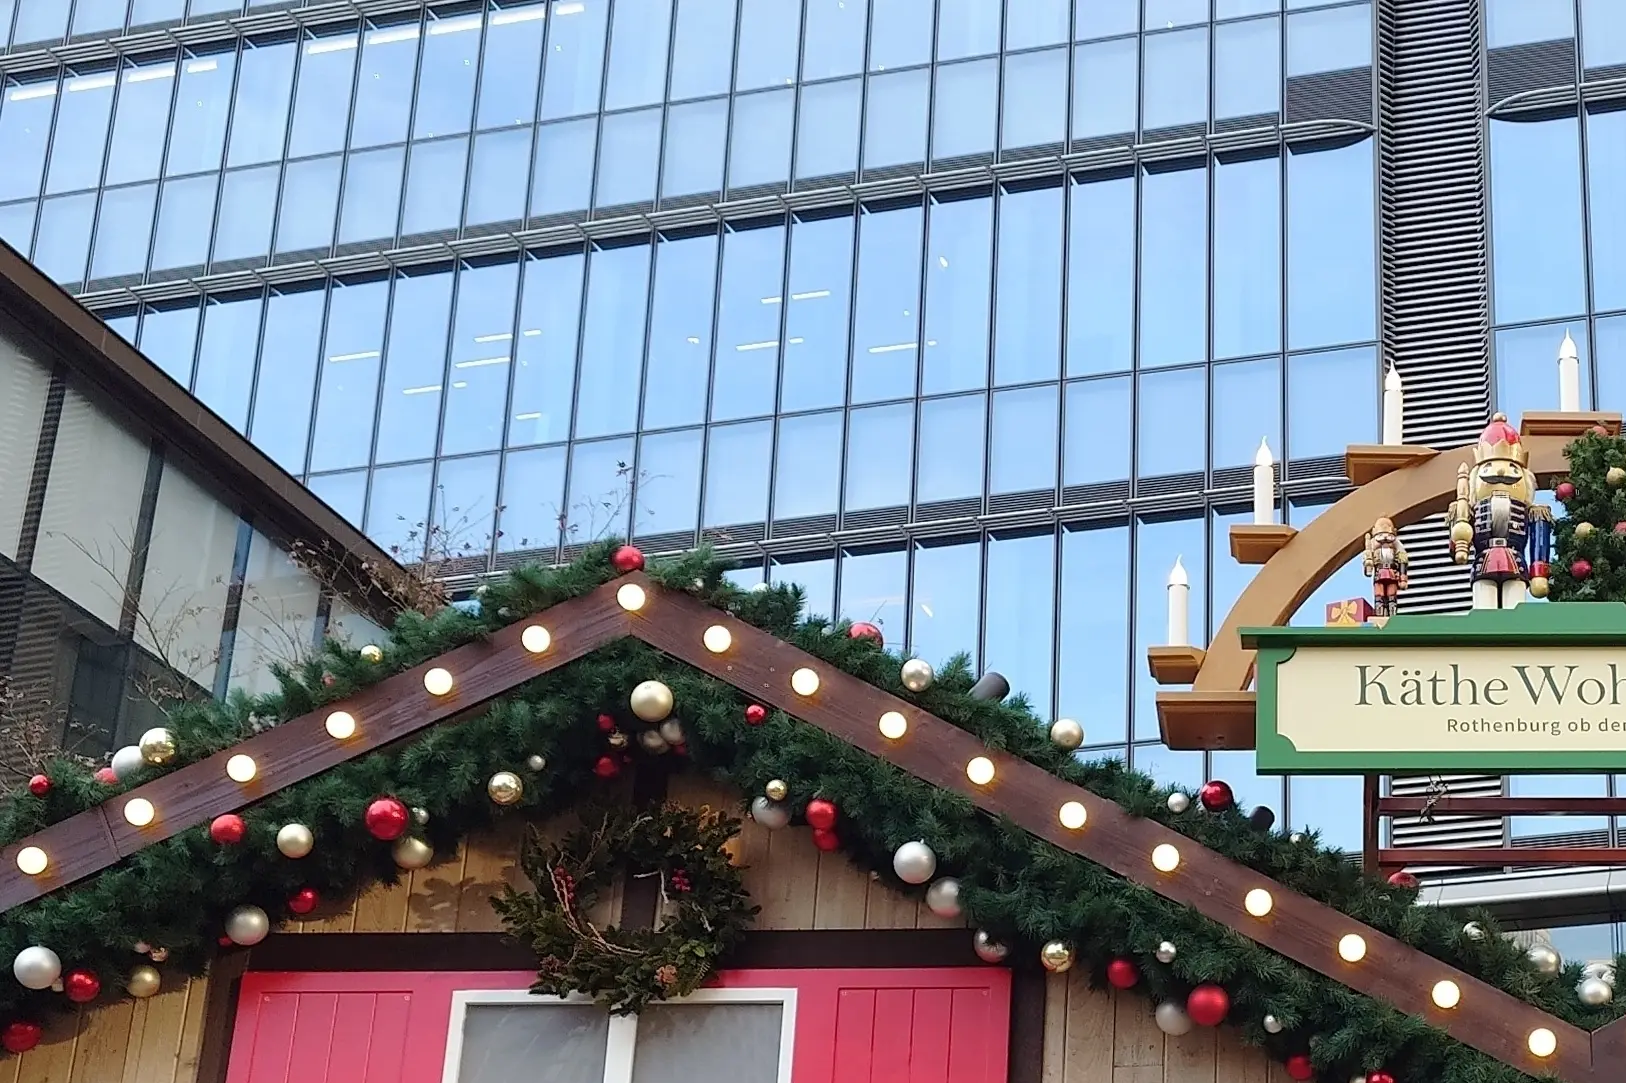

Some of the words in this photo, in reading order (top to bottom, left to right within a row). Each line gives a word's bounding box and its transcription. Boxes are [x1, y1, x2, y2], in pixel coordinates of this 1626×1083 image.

[1354, 663, 1508, 706] Käthe
[1447, 717, 1561, 736] Rothenburg
[1567, 717, 1591, 732] ob
